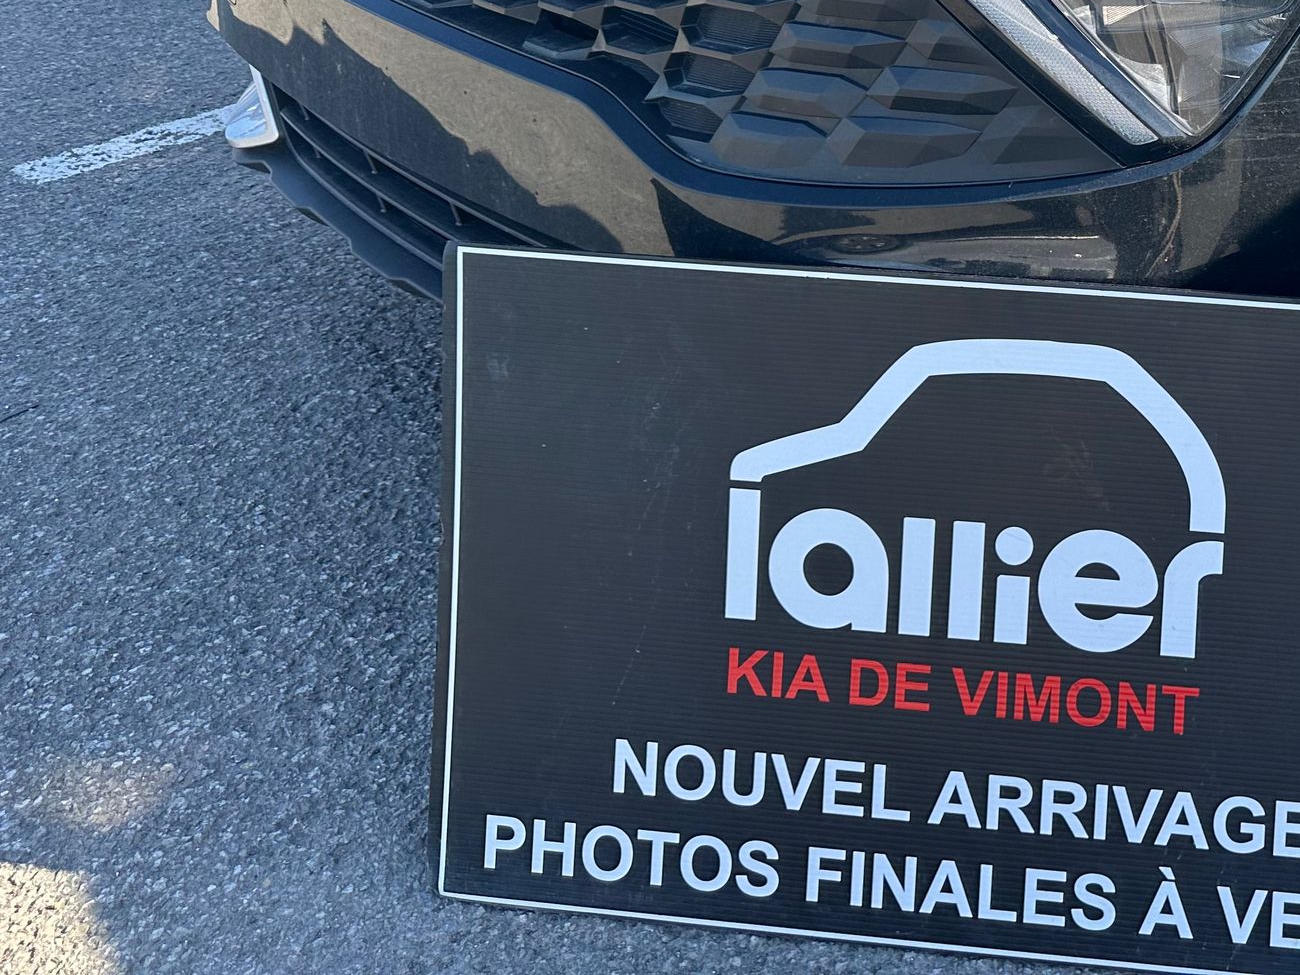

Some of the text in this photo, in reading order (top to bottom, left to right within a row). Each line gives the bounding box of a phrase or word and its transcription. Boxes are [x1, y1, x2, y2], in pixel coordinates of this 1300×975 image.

[724, 487, 1226, 659] lallier
[726, 647, 1201, 736] KIA DE VIMONT
[613, 738, 911, 822] NOUVEL
[483, 814, 780, 898] PHOTOS
[805, 846, 1116, 931] FINALES
[1138, 866, 1194, 940] À
